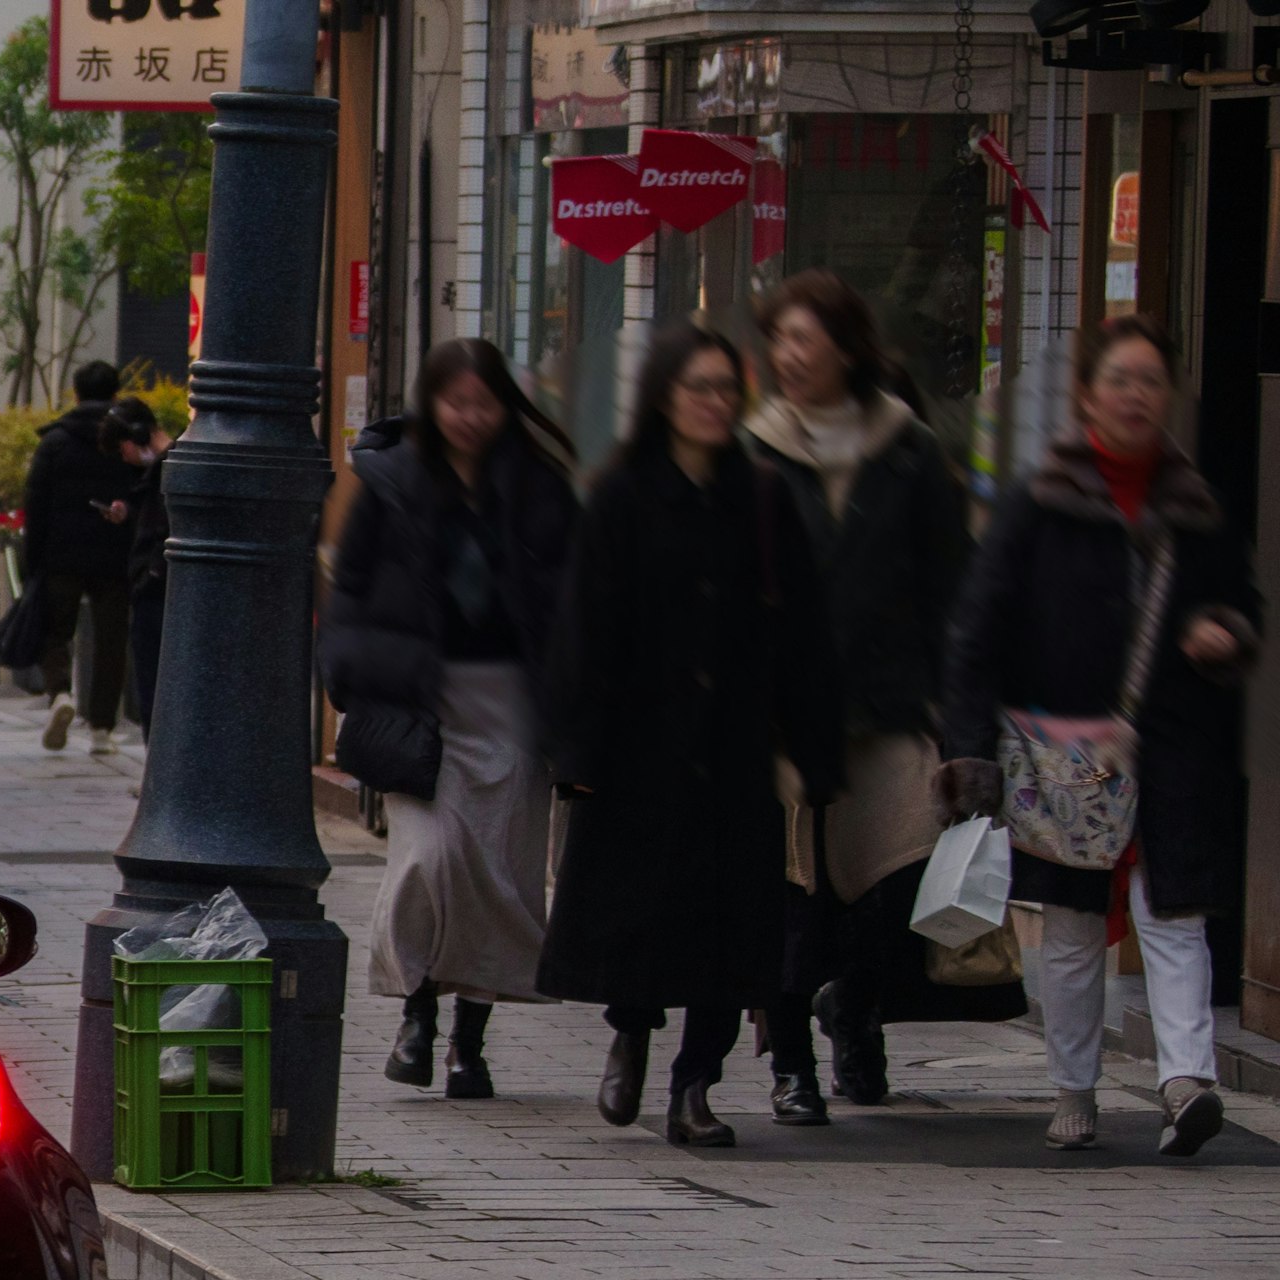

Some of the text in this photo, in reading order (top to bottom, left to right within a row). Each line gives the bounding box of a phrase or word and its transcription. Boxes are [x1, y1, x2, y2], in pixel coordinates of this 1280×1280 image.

[76, 46, 229, 82] 赤坂店
[640, 168, 746, 188] Dr.stretch
